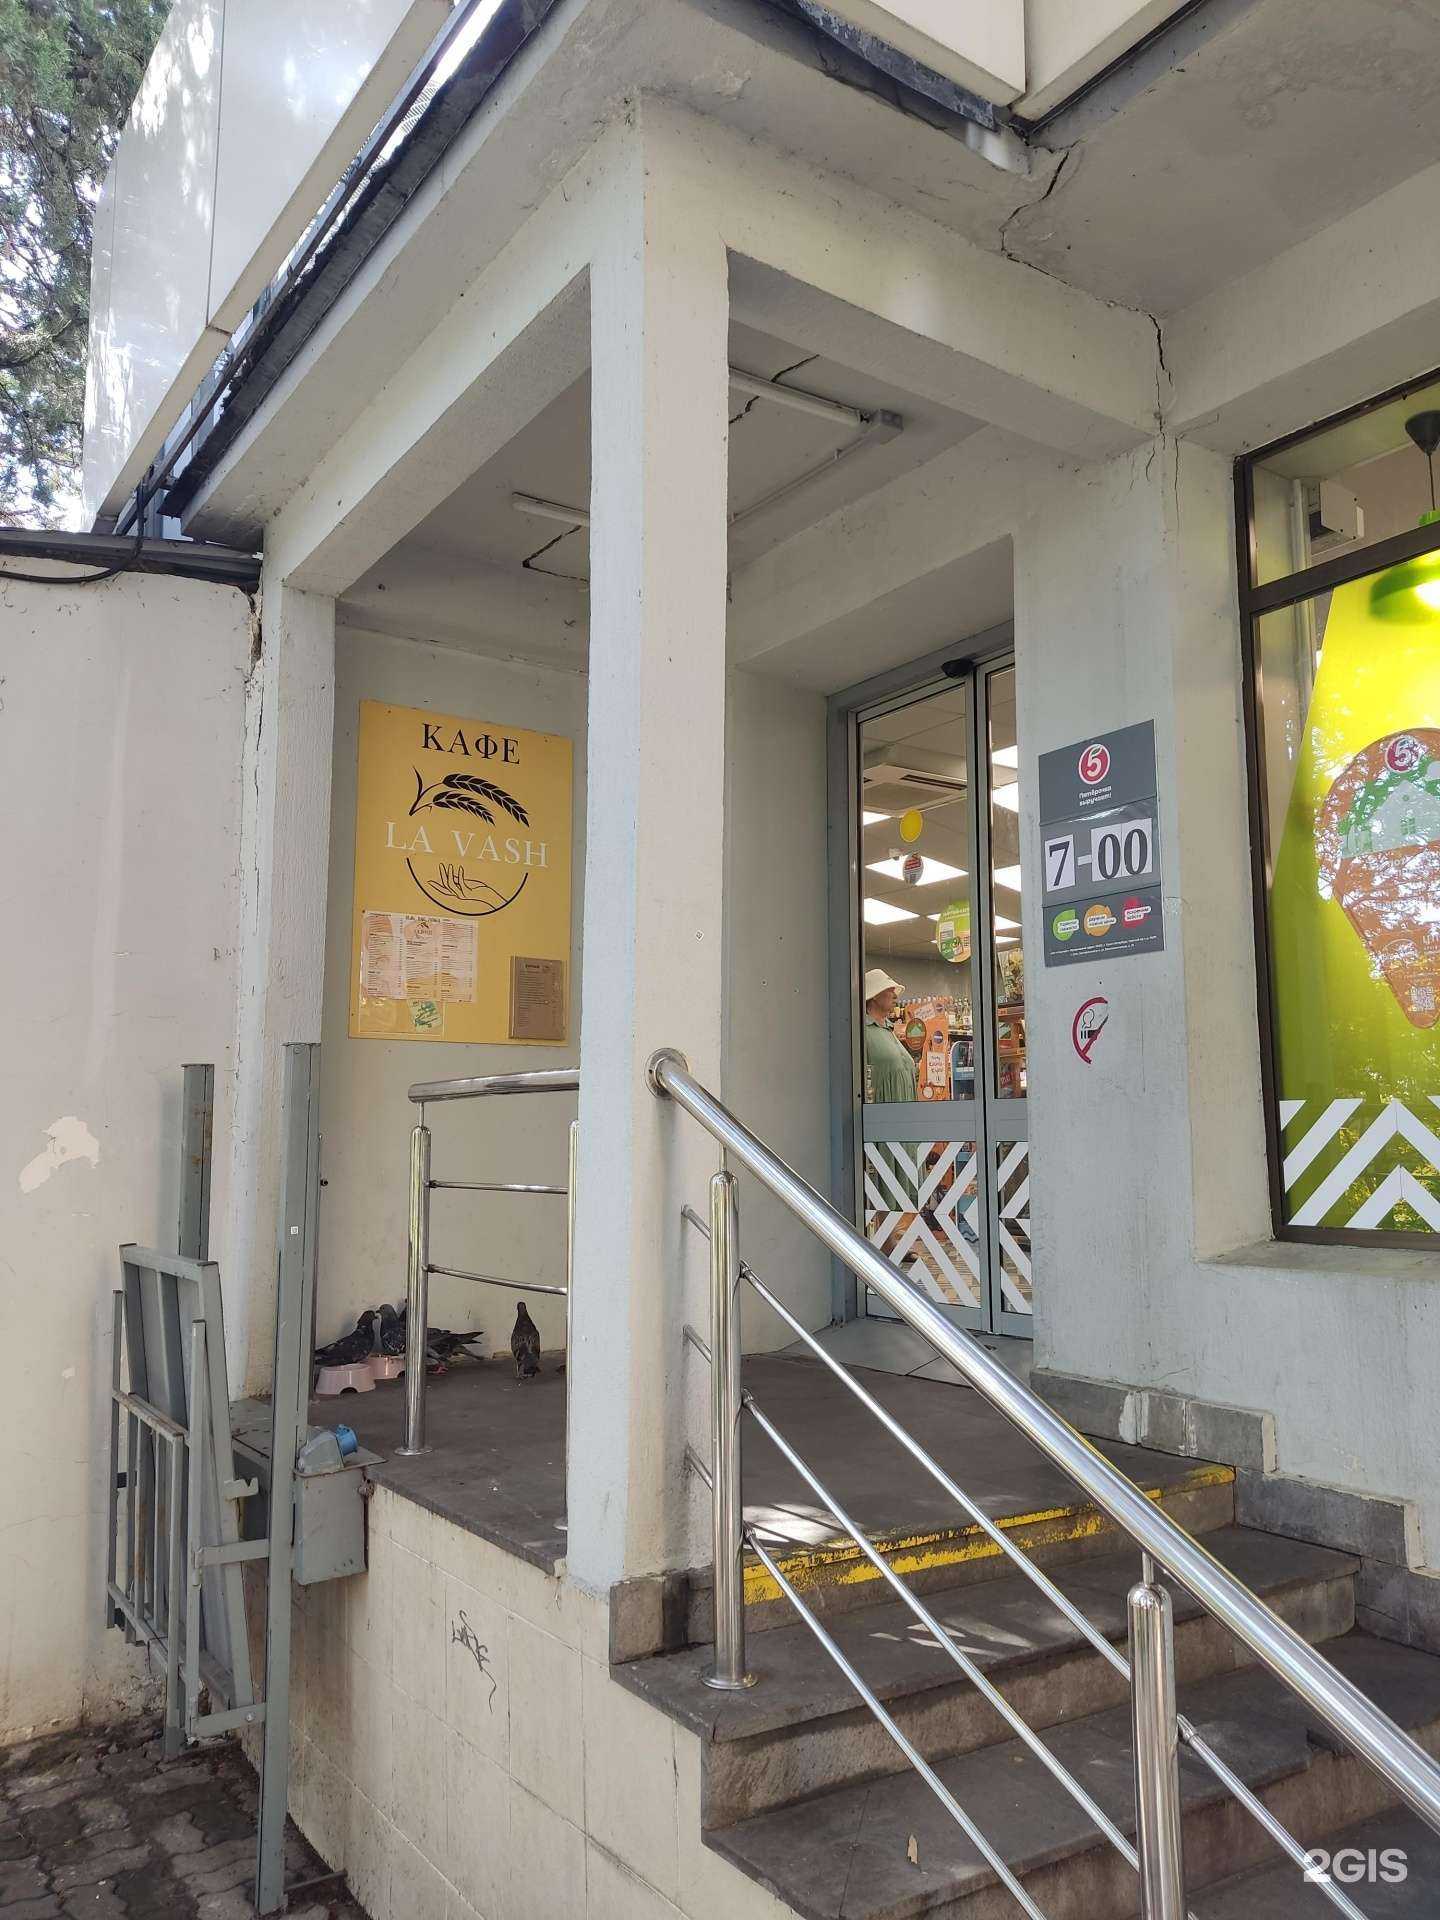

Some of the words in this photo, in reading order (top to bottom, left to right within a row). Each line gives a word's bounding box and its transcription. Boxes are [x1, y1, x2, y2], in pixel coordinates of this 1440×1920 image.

[421, 722, 521, 765] КАФЕ
[385, 821, 434, 855] LA
[451, 830, 549, 869] VASH
